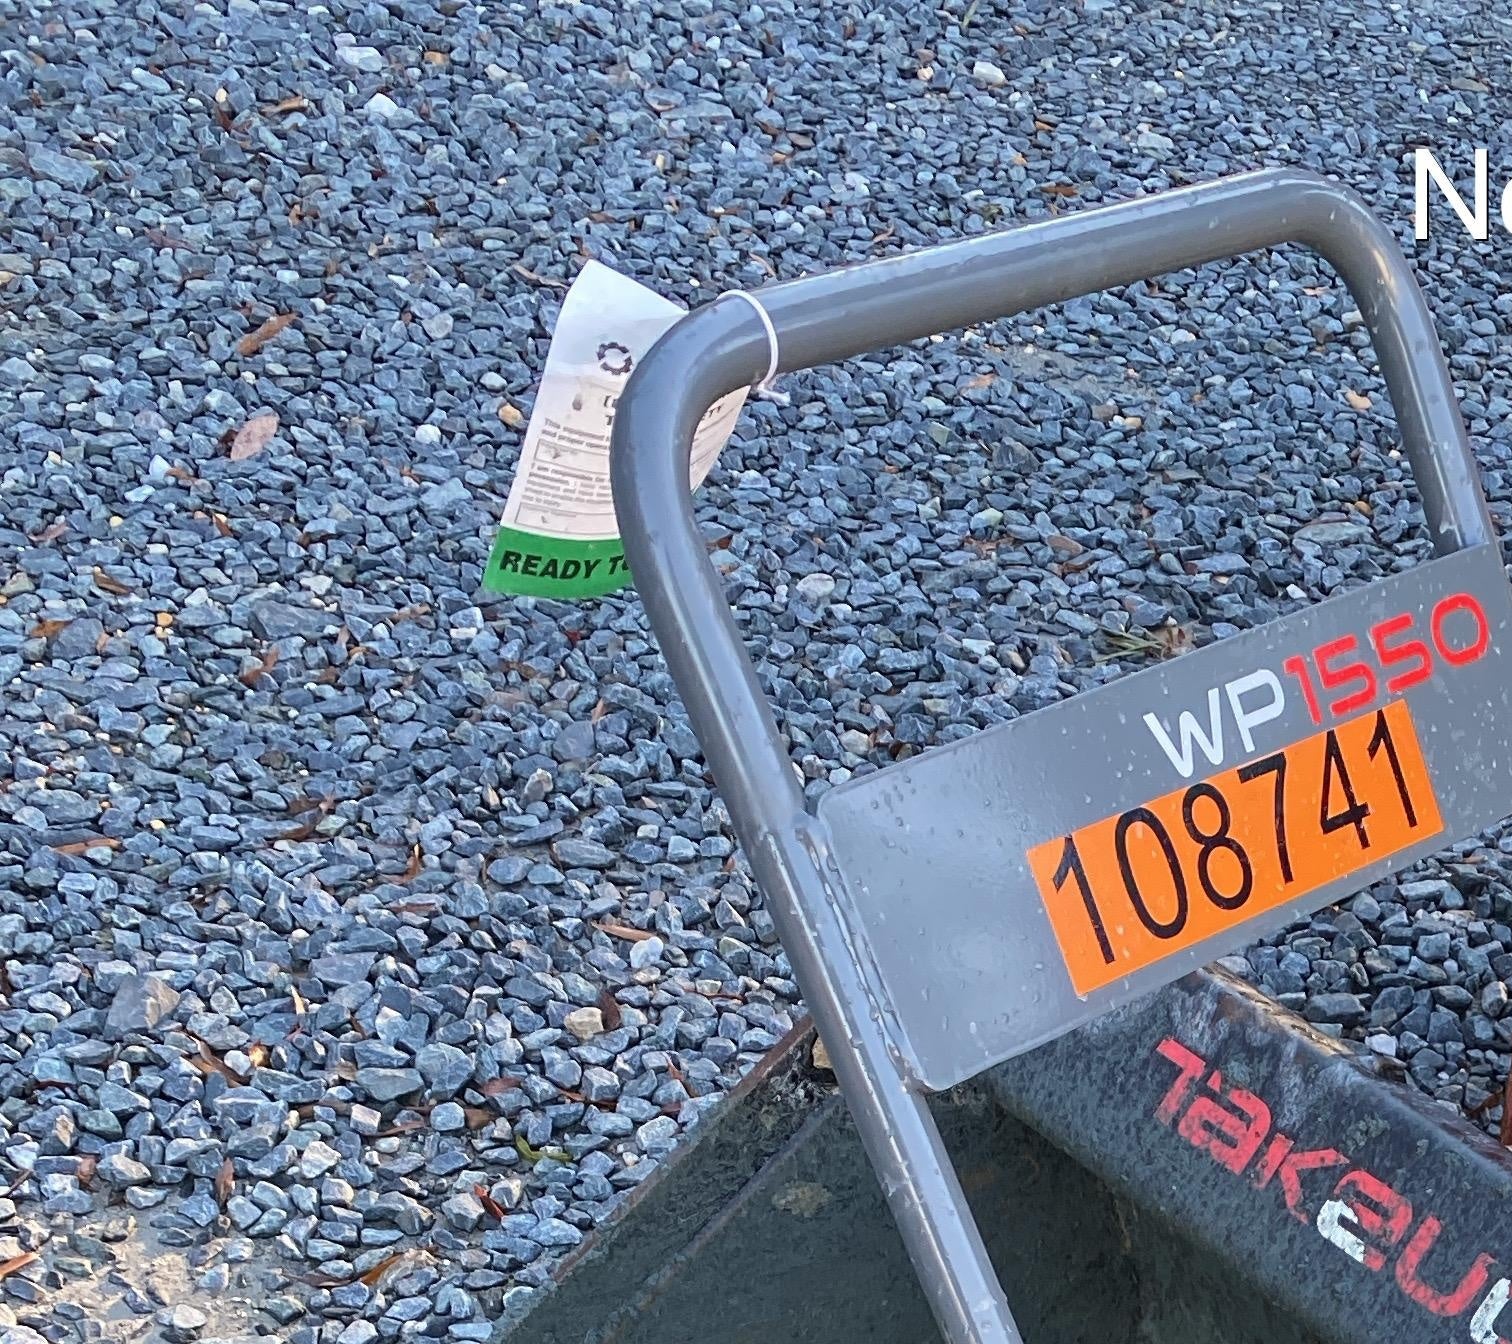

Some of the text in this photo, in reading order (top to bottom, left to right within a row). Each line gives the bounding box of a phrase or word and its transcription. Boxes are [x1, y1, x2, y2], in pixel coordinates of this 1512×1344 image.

[500, 549, 603, 581] READY
[1142, 592, 1491, 778] WP1550
[1051, 709, 1418, 966] 108741
